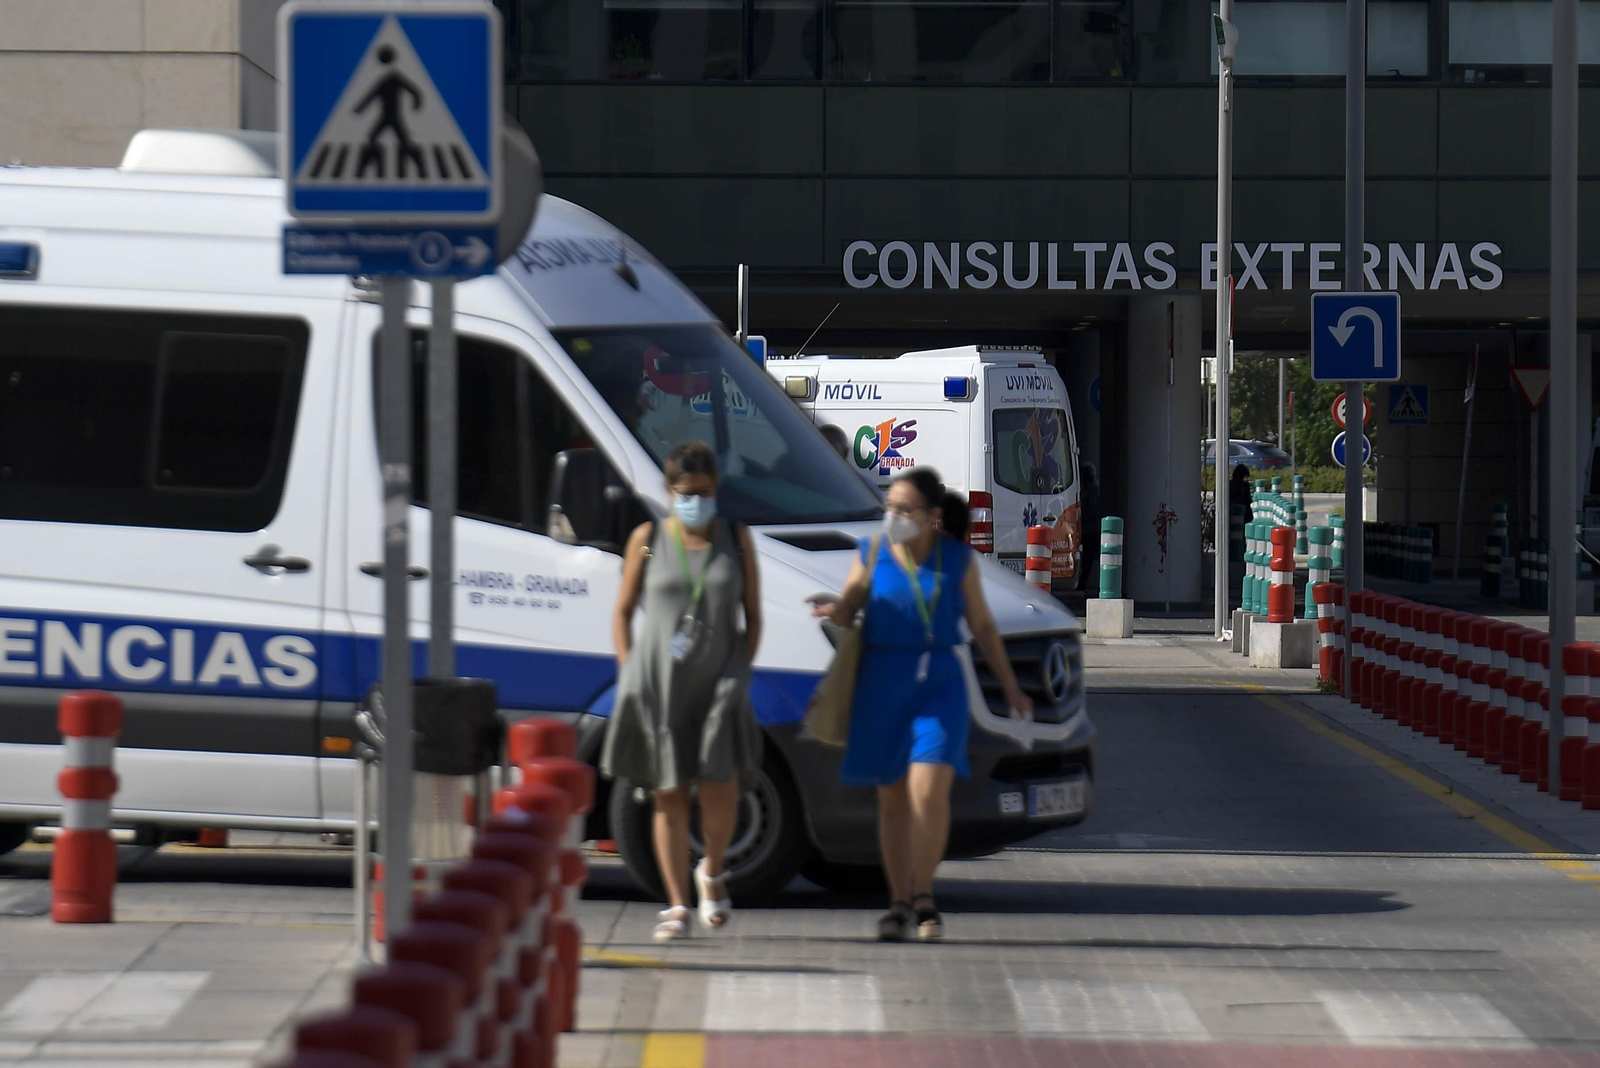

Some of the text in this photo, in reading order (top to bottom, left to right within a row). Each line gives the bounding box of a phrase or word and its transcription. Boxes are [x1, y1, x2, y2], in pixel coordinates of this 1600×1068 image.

[843, 240, 1504, 291] CONSULTAS EXTERNAS
[824, 377, 882, 400] MÓVIL
[1005, 370, 1054, 390] UVI MÓVIL
[853, 416, 918, 469] CTS
[880, 457, 915, 468] GRANADA
[453, 569, 515, 590] HAMBRA
[525, 574, 589, 596] GRANADA
[0, 617, 318, 687] ENCIAS
